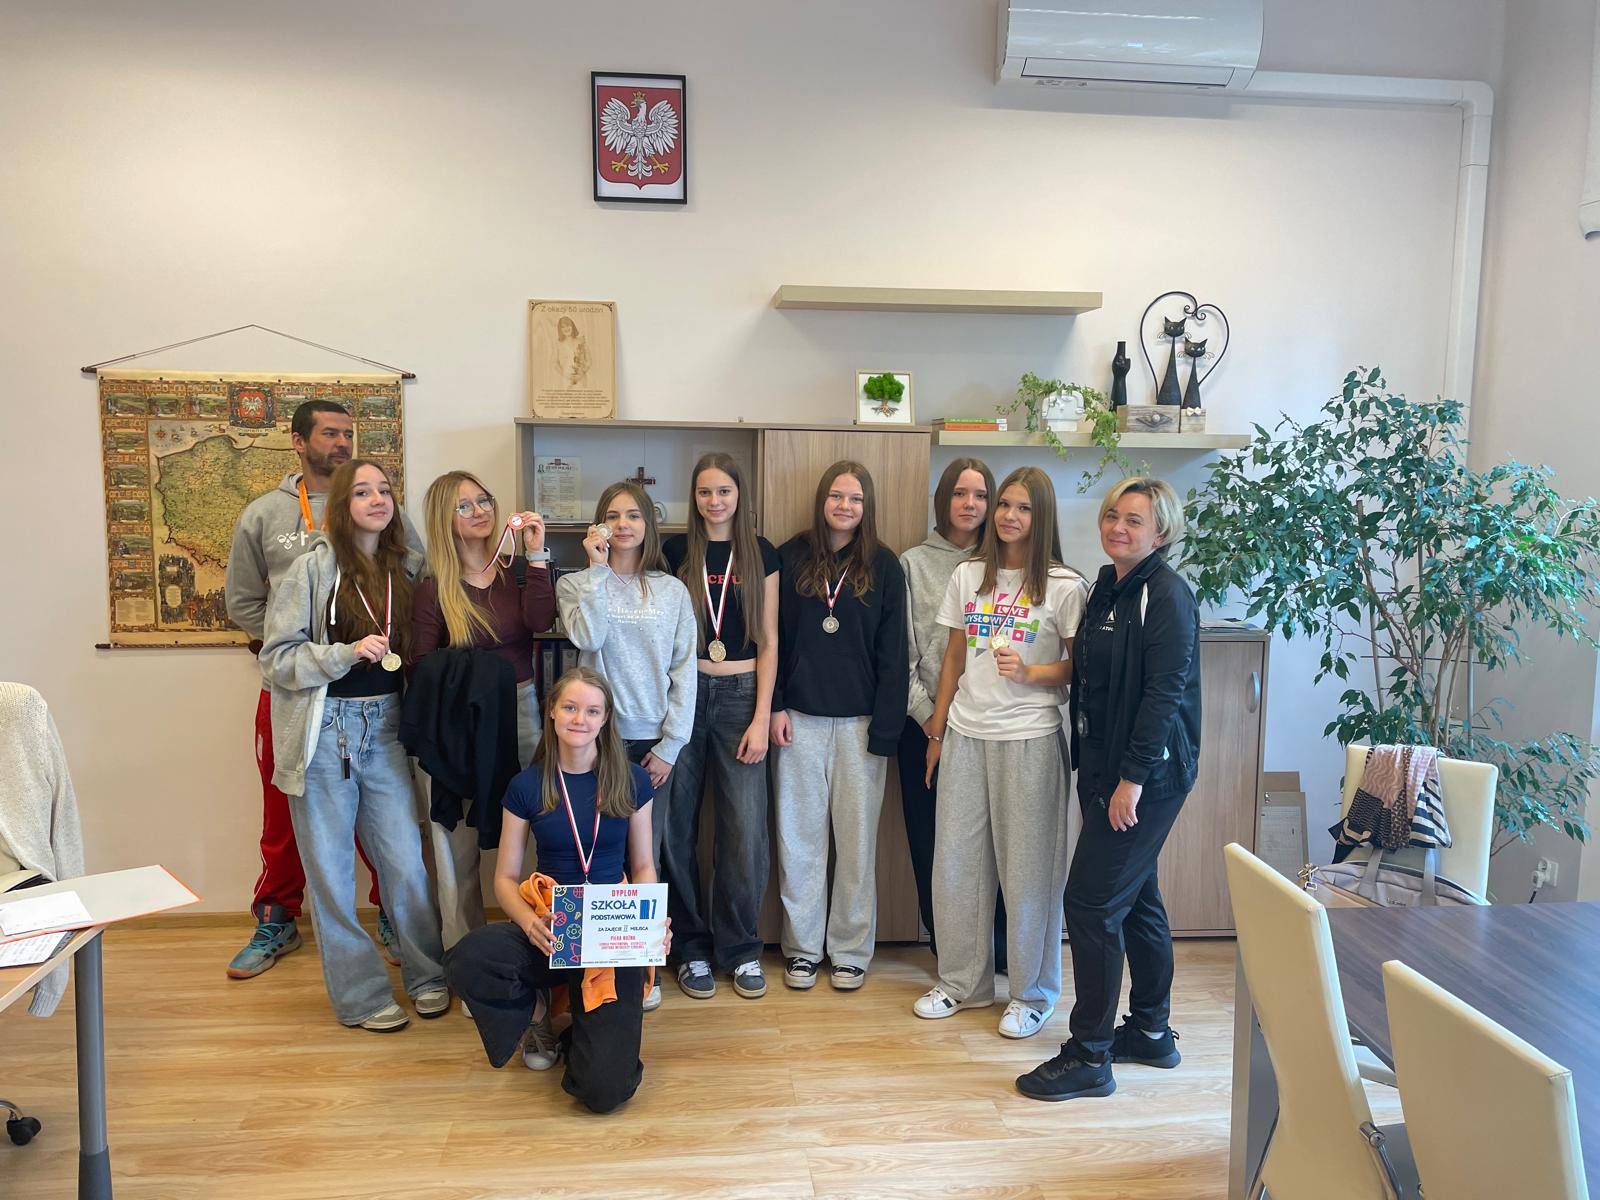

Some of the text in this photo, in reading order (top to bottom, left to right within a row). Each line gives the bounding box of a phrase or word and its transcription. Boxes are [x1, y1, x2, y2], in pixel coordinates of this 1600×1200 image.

[611, 889, 638, 897] DYPLOM
[591, 899, 637, 910] SZKOŁA
[591, 913, 637, 921] PODSTAWOWA
